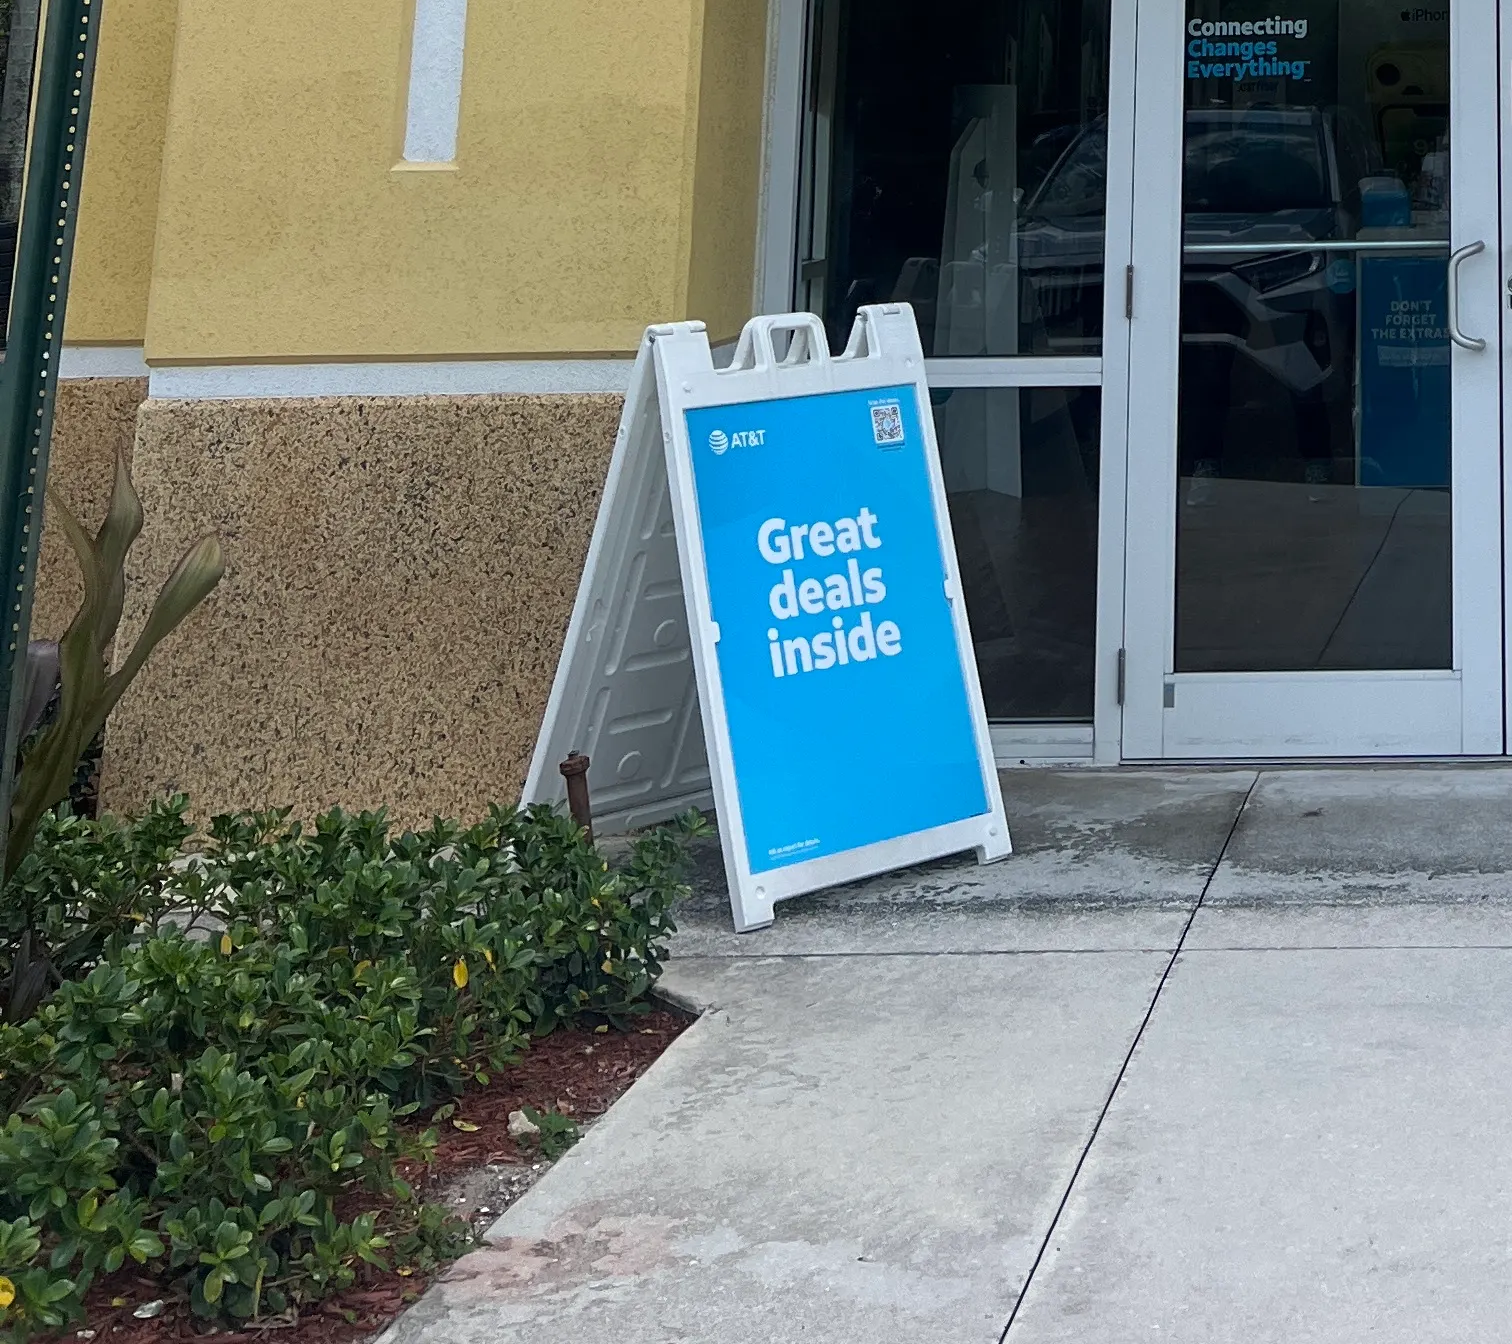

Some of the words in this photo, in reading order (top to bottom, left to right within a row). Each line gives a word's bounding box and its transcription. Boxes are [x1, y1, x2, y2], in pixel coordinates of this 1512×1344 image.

[1188, 16, 1308, 39] Connecting
[1188, 38, 1278, 61] Changes
[1188, 57, 1305, 81] Everything
[1391, 300, 1432, 312] DON'T
[1385, 313, 1436, 325] FORGET
[1371, 328, 1396, 339] THE
[731, 429, 767, 449] AT&T
[757, 506, 882, 565] Great
[768, 558, 887, 620] deals
[767, 612, 903, 678] inside
